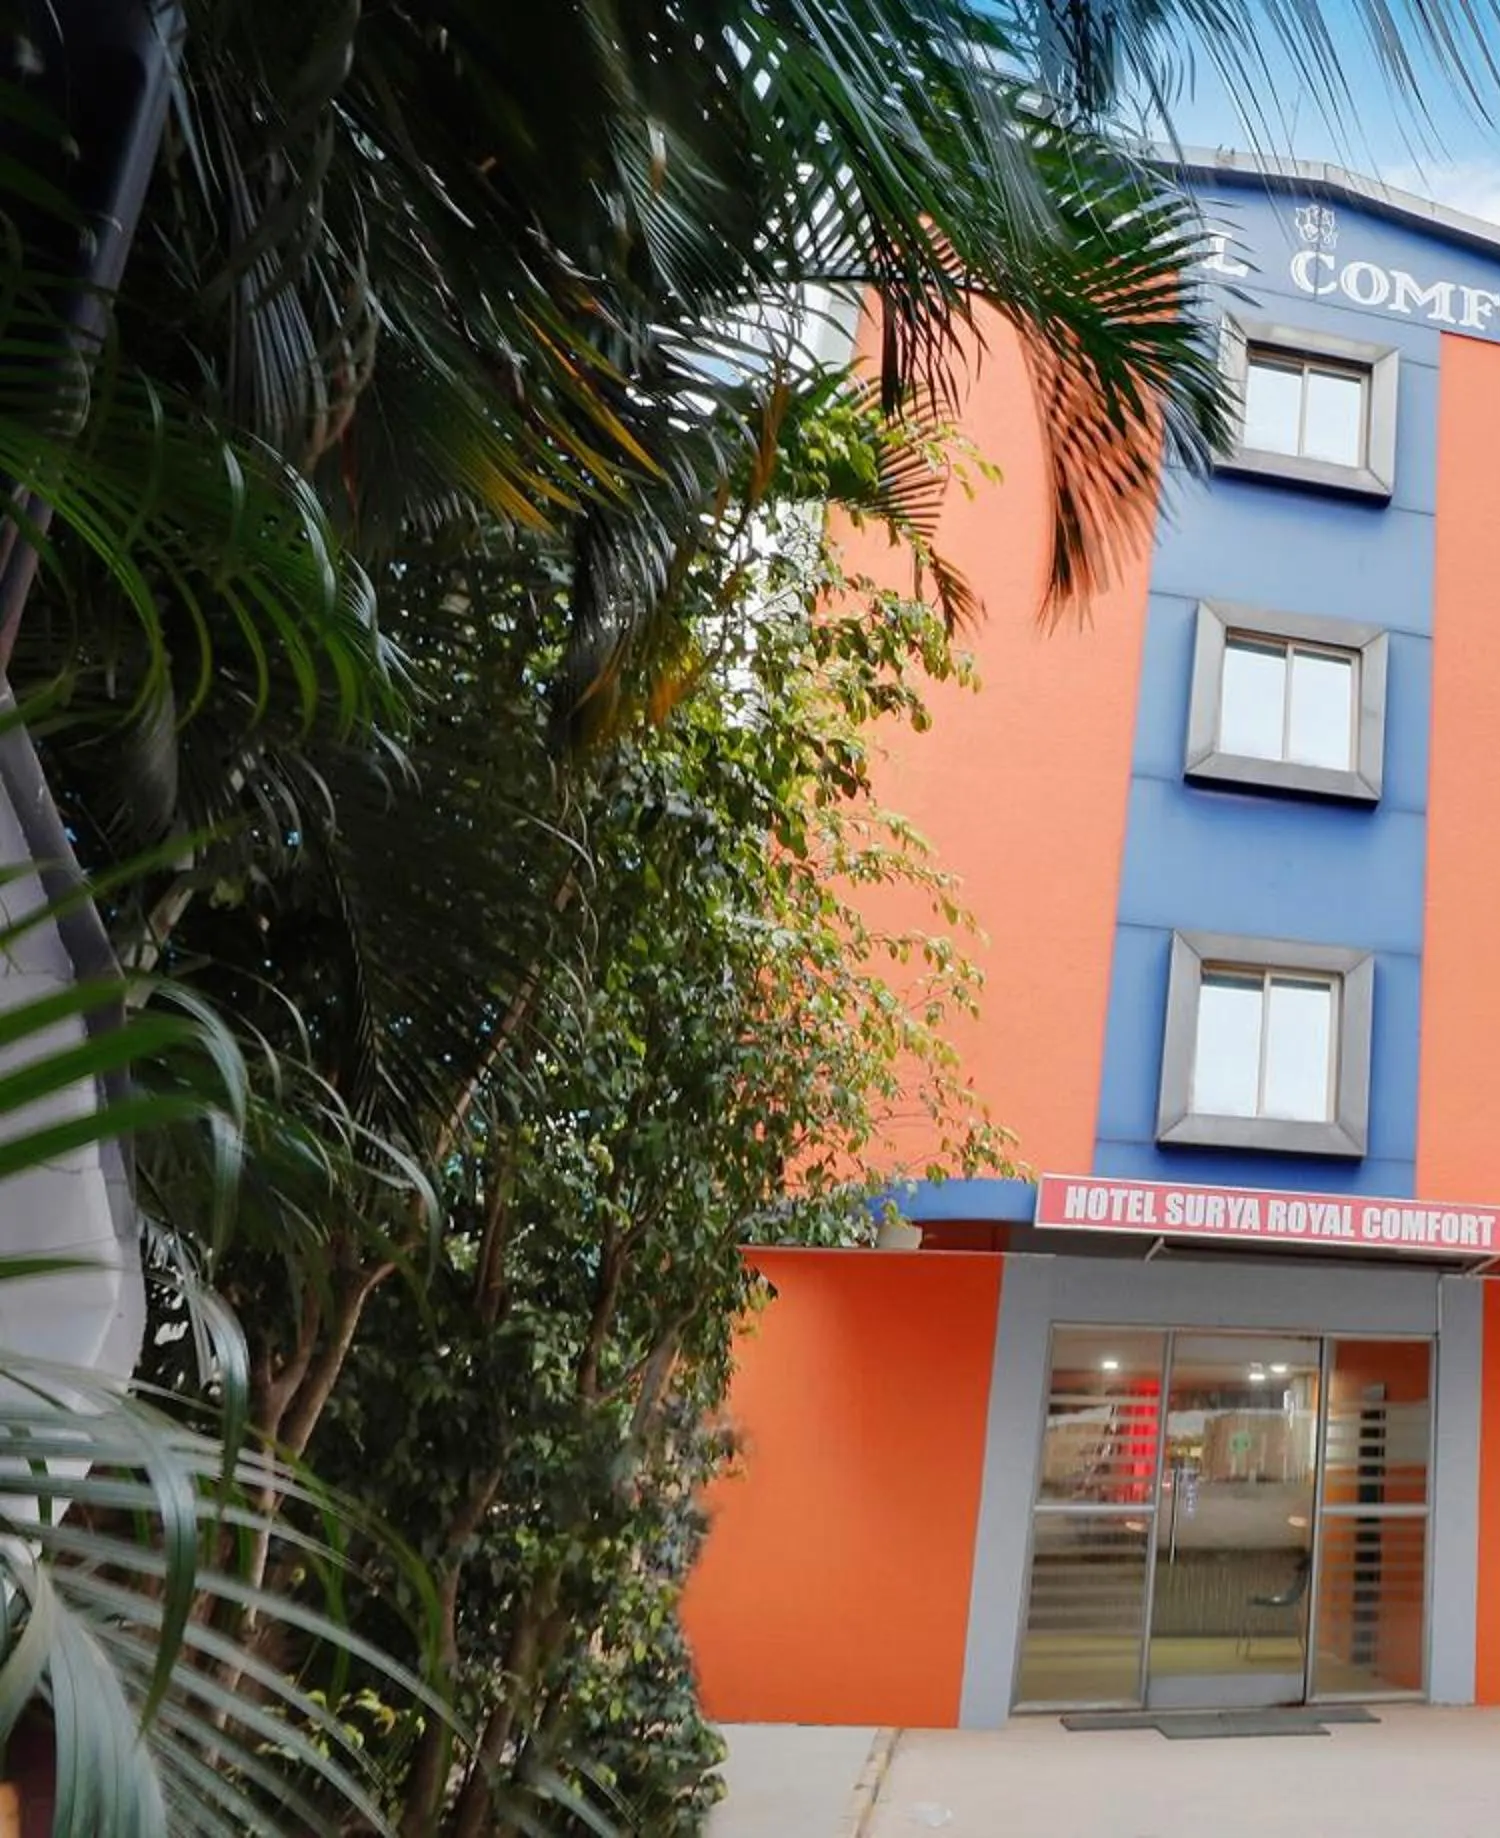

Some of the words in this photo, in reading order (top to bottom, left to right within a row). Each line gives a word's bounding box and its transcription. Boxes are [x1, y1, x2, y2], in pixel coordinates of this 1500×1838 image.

[1065, 1186, 1157, 1223] HOTEL
[1165, 1193, 1260, 1231] SURYA
[1267, 1199, 1355, 1237] ROYAL
[1362, 1207, 1495, 1246] COMFORT
